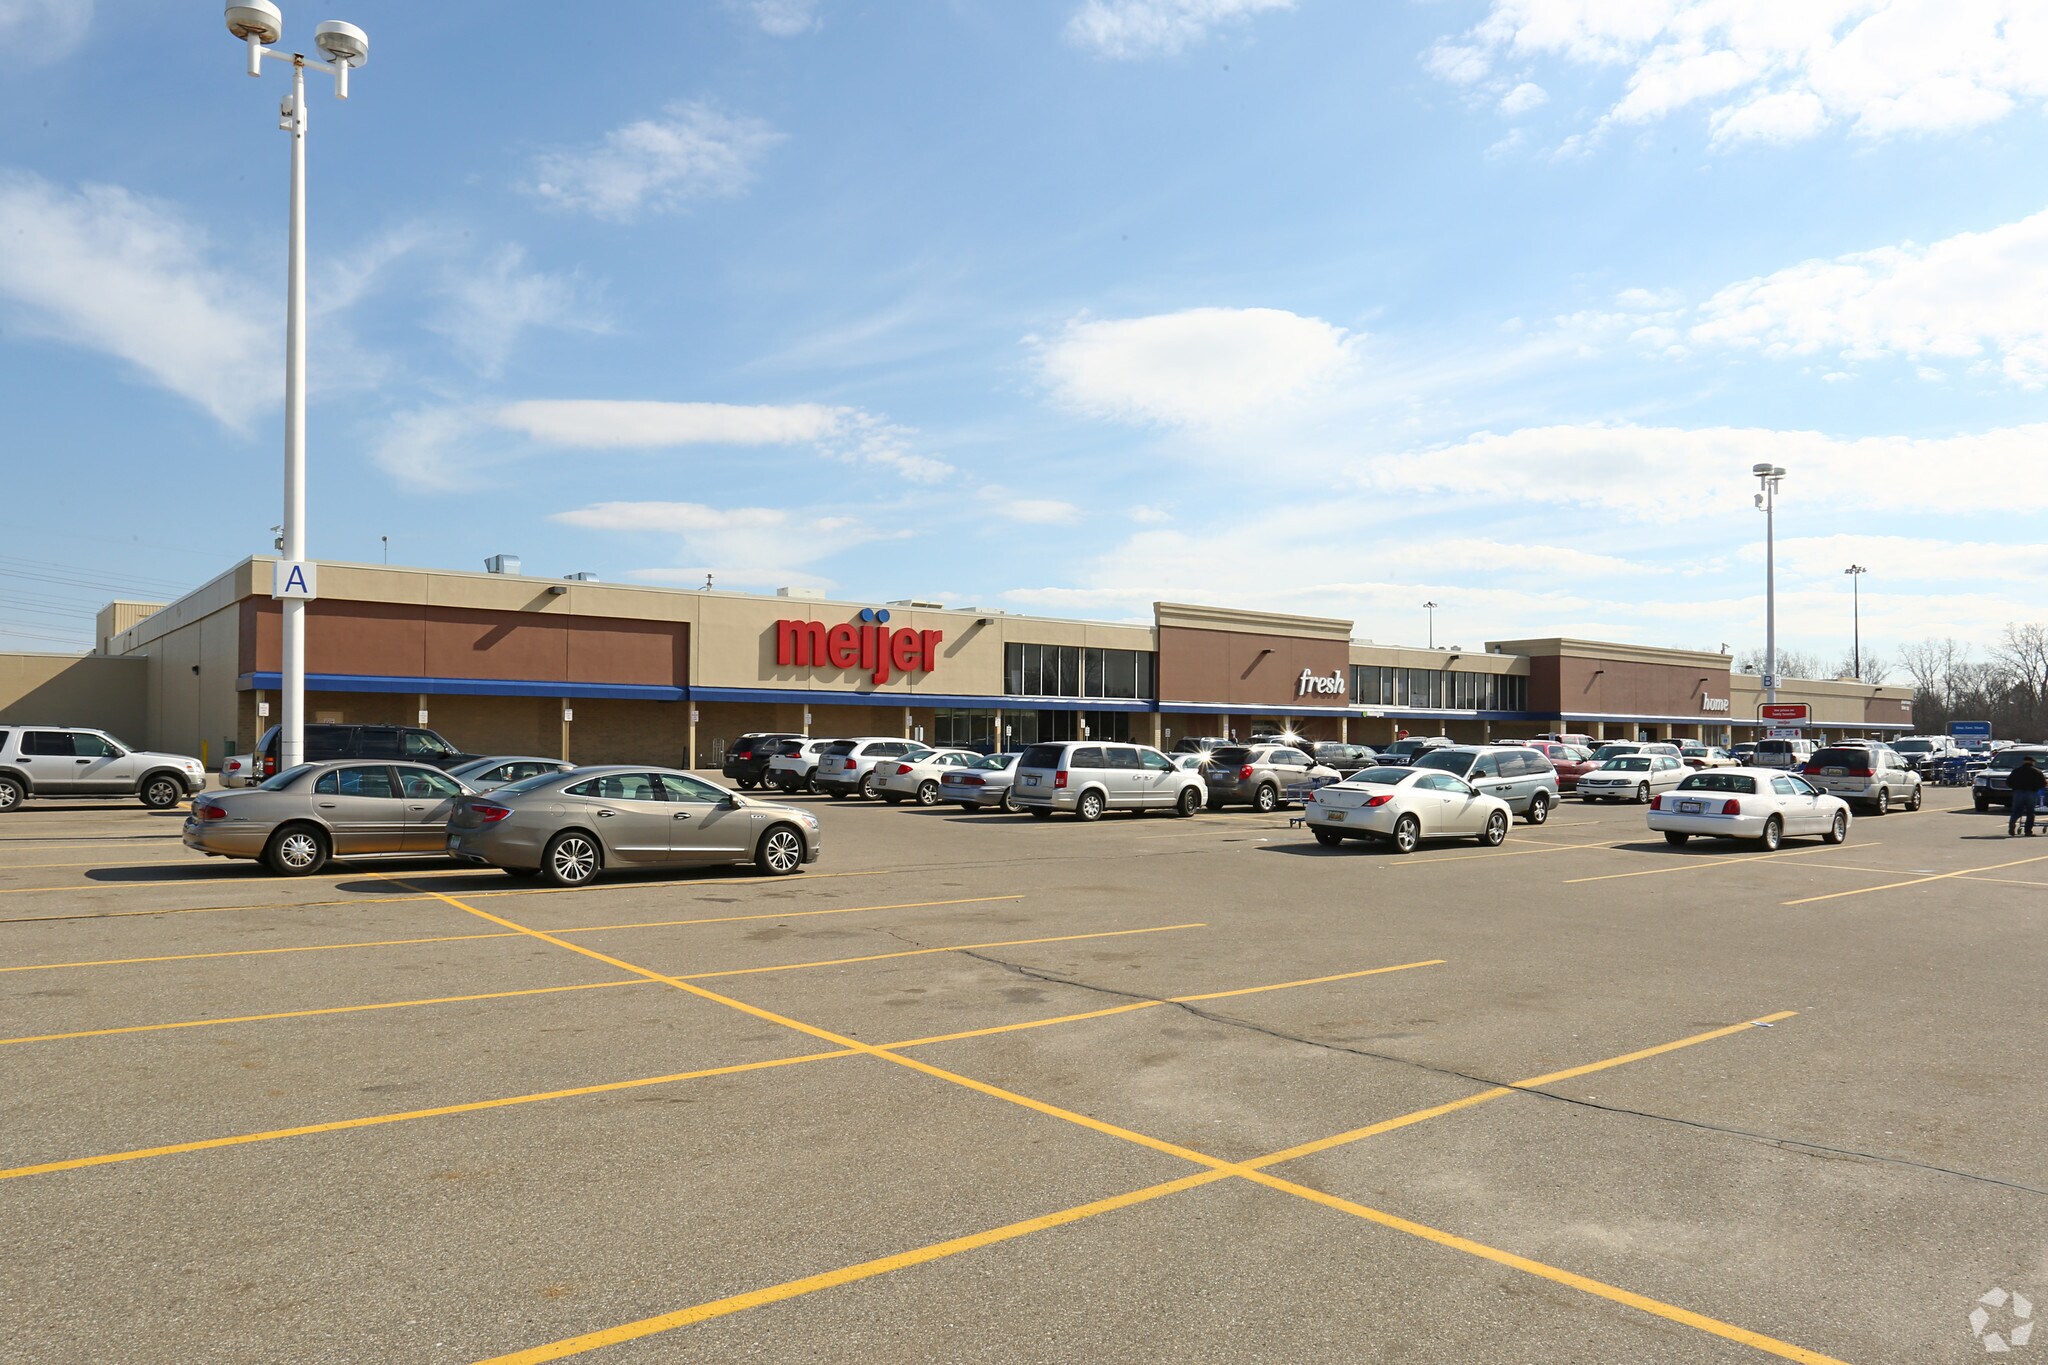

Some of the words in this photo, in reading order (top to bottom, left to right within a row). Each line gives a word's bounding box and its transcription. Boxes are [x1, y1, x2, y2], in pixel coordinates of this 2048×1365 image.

[285, 565, 308, 593] A
[777, 608, 943, 685] meijer
[1299, 668, 1346, 696] fresh
[1763, 675, 1773, 687] B
[1703, 692, 1729, 711] home
